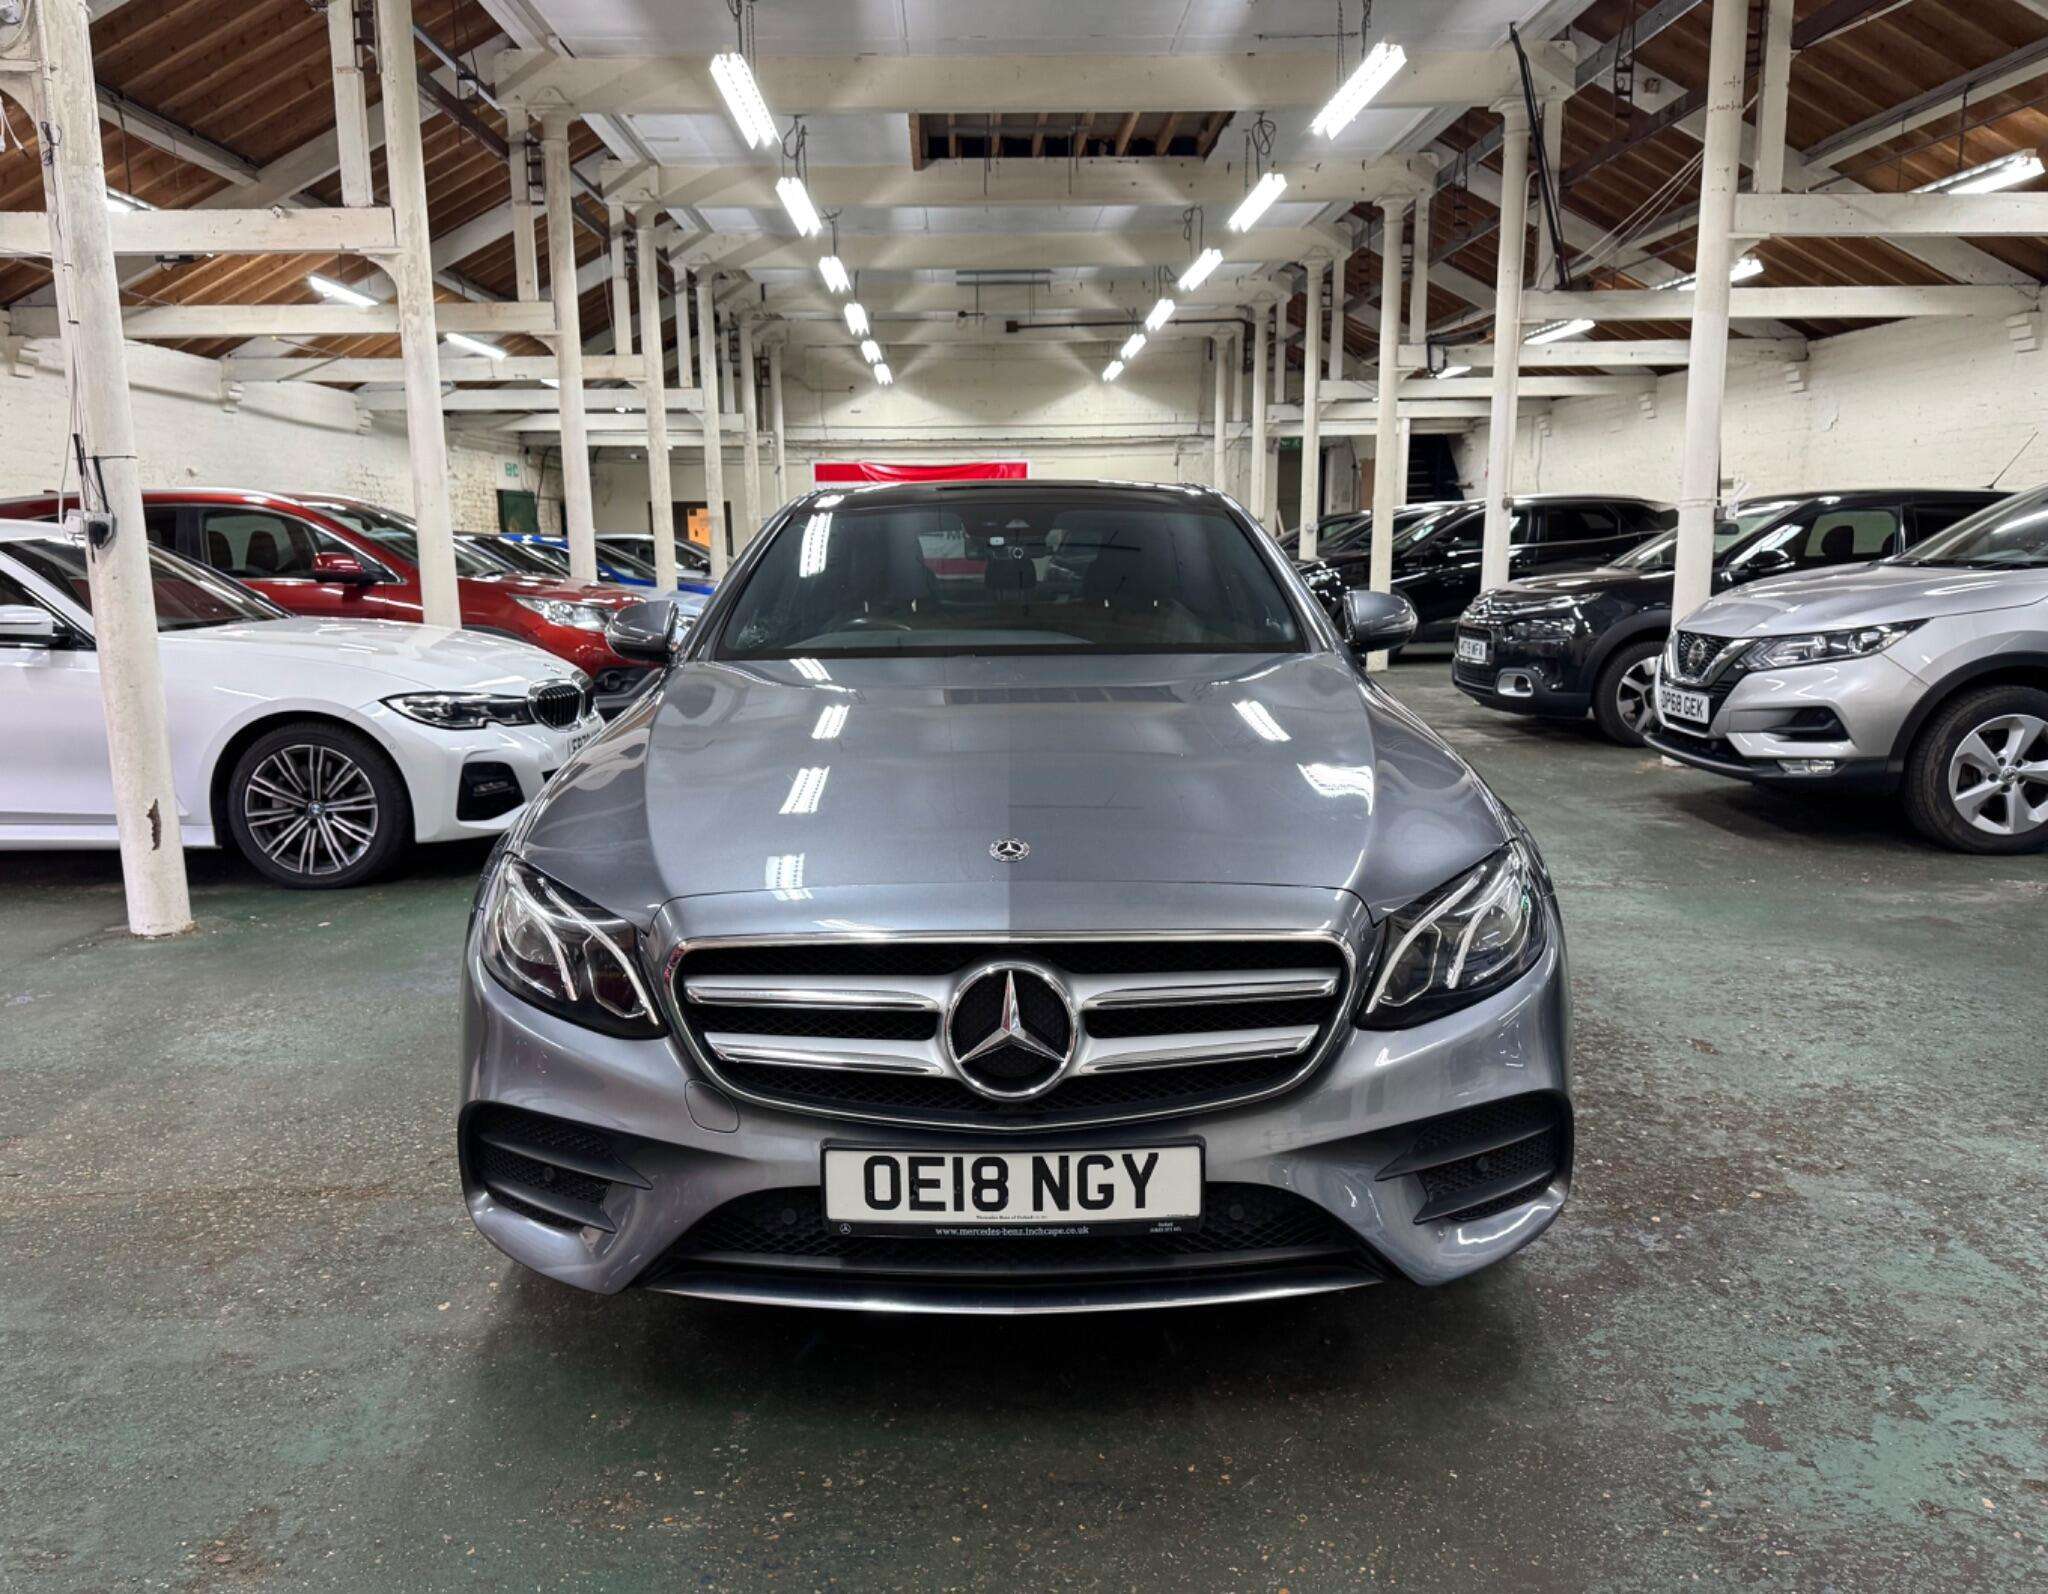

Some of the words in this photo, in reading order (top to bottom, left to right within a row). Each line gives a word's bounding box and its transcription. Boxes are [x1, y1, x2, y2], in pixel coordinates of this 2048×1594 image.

[1684, 696, 1704, 718] GEK
[863, 1154, 1010, 1212] OE18
[1031, 1152, 1160, 1212] NGY
